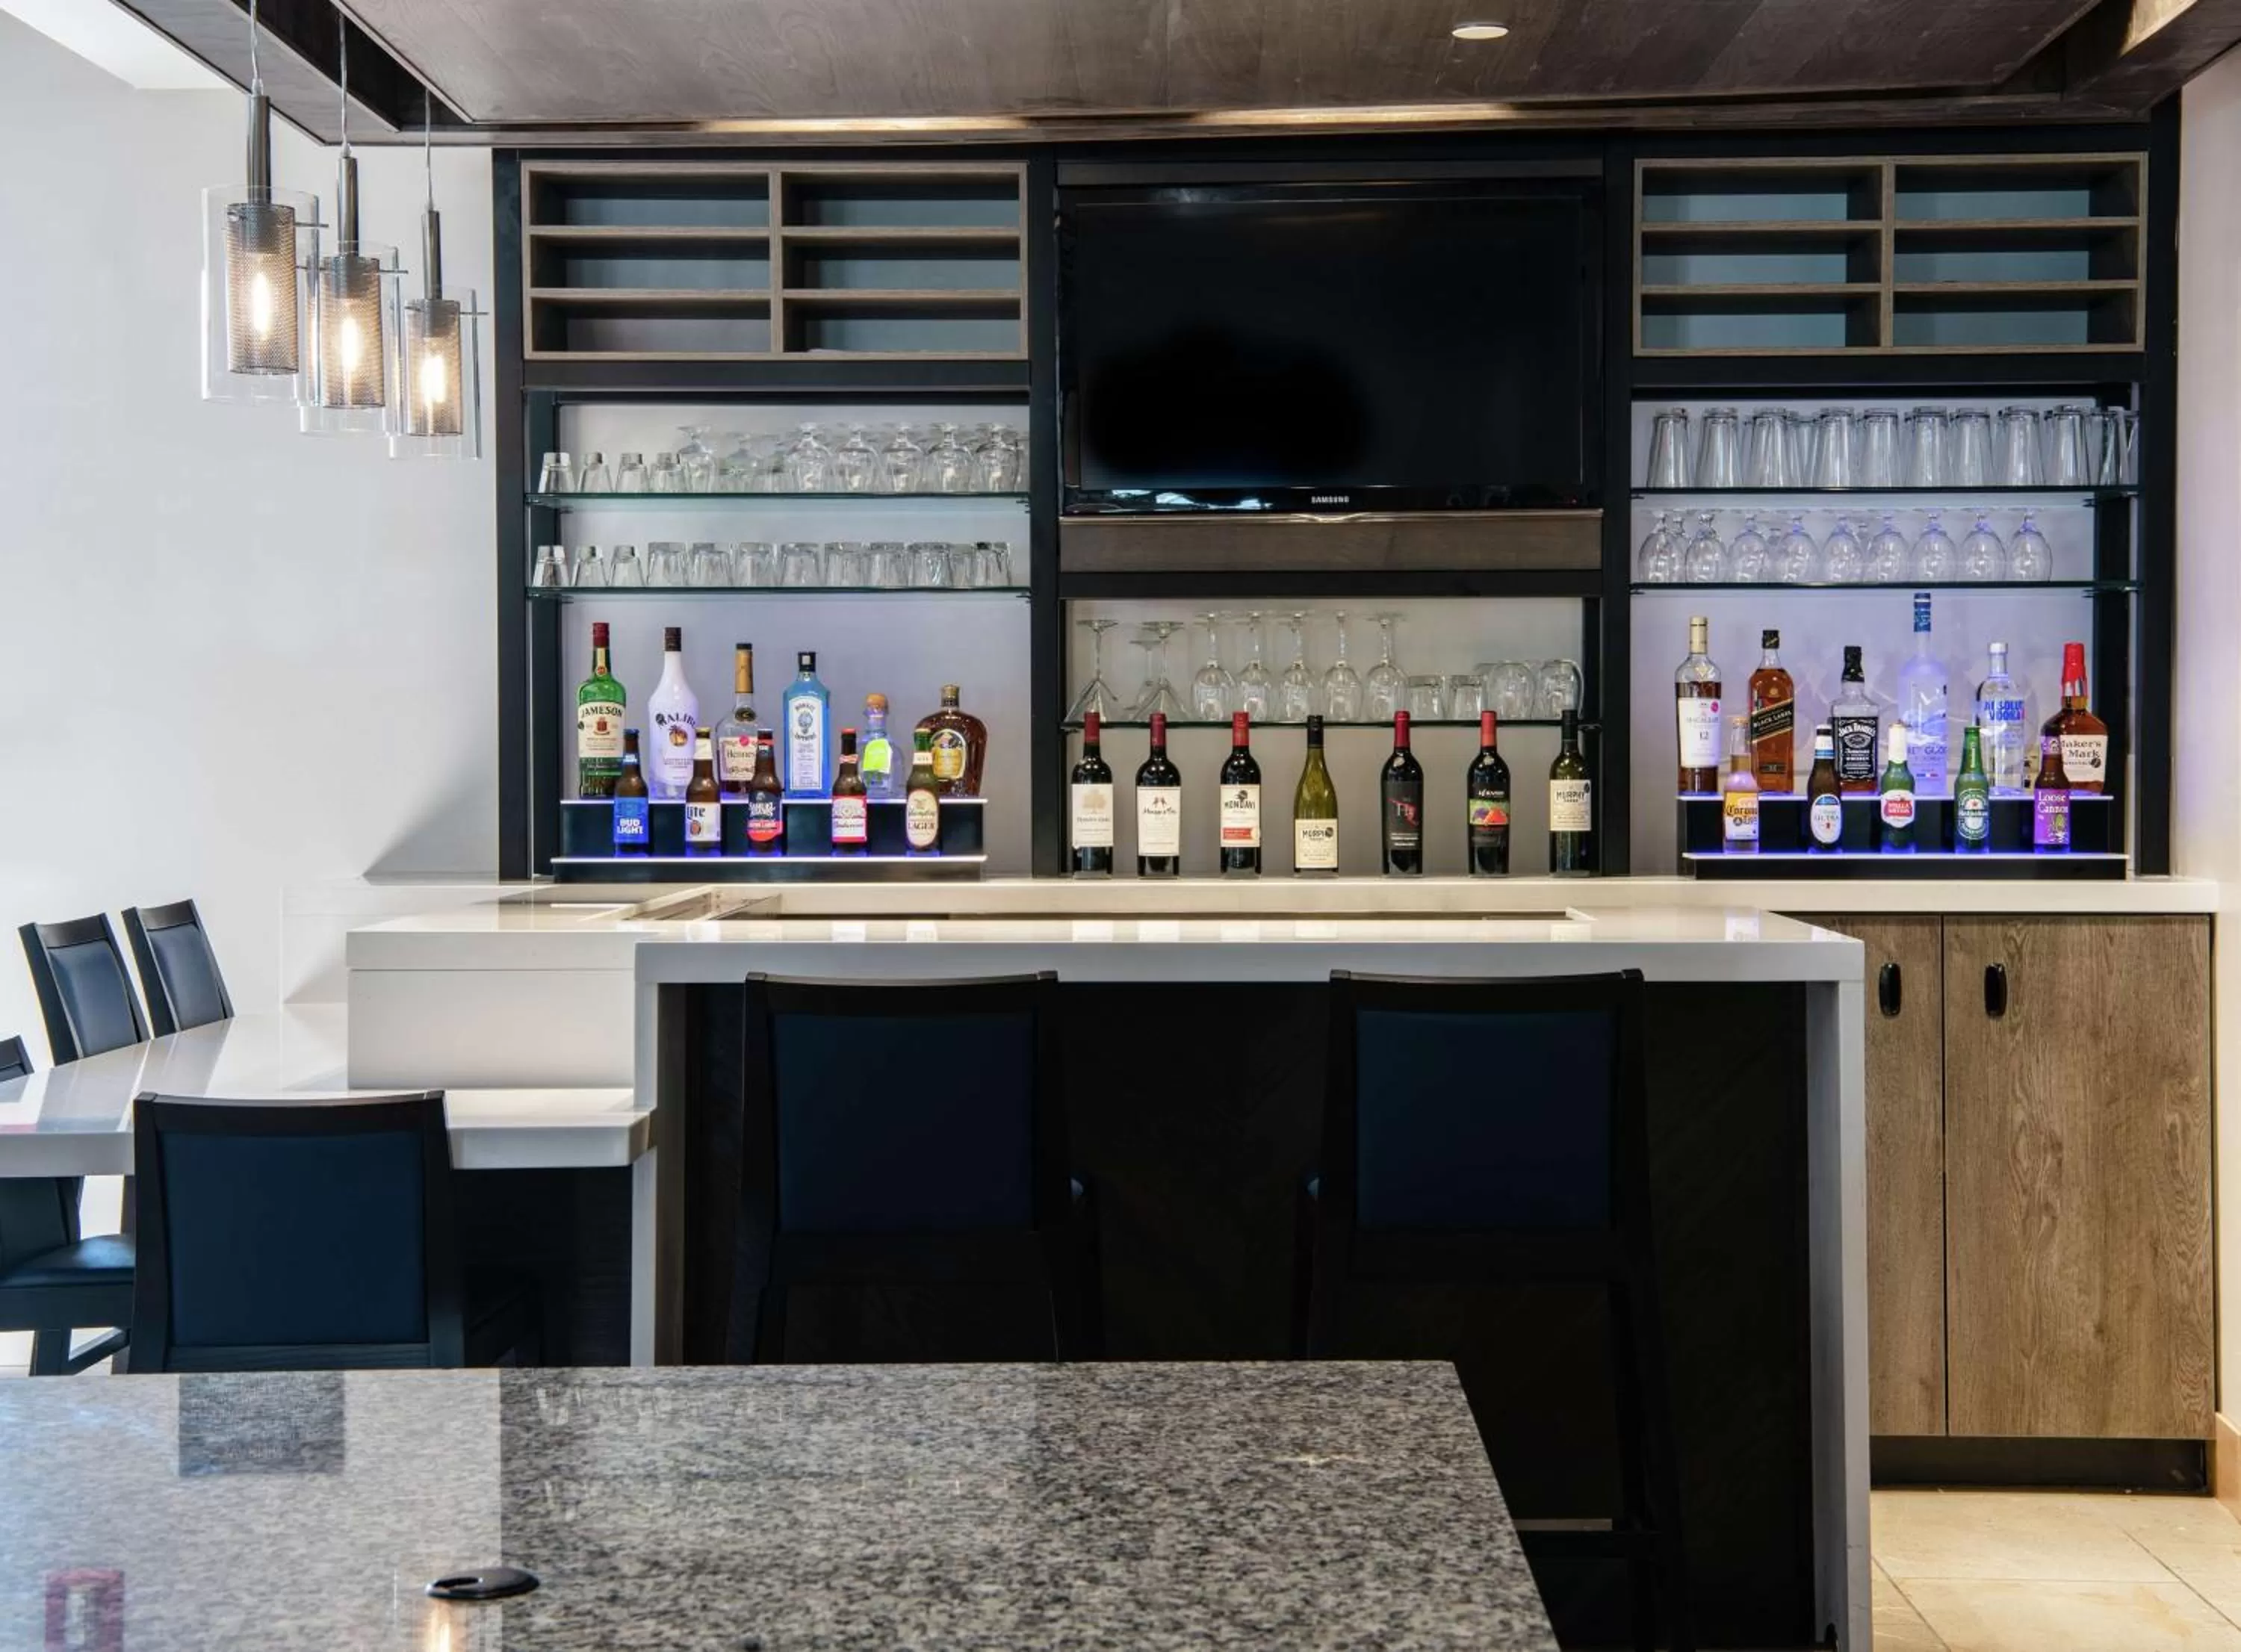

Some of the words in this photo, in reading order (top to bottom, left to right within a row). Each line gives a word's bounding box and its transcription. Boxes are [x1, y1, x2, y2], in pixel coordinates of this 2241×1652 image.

[581, 706, 622, 718] JAMESON
[1838, 725, 1853, 737] JACK
[2068, 749, 2100, 758] Mark
[2038, 791, 2067, 801] Loose
[619, 818, 641, 826] BUD
[616, 825, 644, 834] LIGHT
